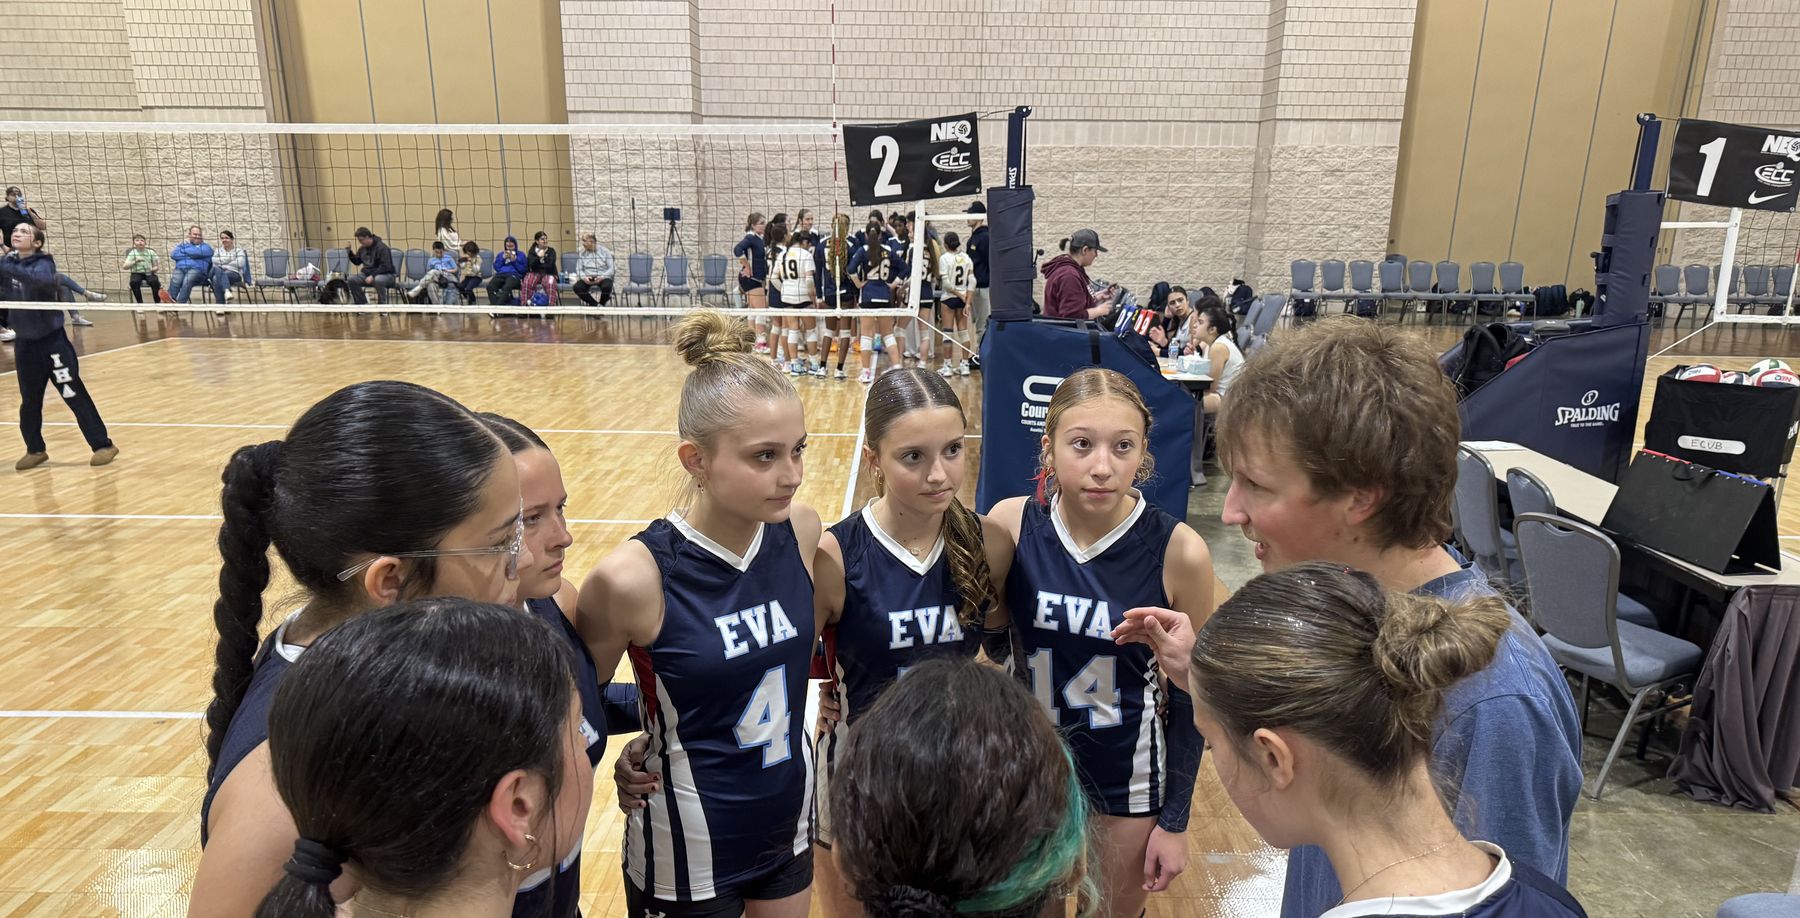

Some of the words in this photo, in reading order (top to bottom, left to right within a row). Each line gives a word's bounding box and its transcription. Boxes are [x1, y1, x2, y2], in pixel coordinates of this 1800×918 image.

[931, 120, 972, 144] NEQ
[940, 152, 971, 166] ECC
[1760, 134, 1800, 162] NEQ
[870, 135, 902, 197] 2
[1696, 137, 1727, 197] 1
[1761, 167, 1795, 181] ECC
[782, 259, 798, 280] 19
[867, 259, 890, 280] 26
[955, 266, 964, 286] 2
[1021, 402, 1048, 418] Cour
[1555, 402, 1621, 426] SPALDING
[888, 605, 965, 650] EVA
[1033, 590, 1114, 641] EVA
[714, 600, 799, 660] EVA
[1027, 647, 1122, 730] 14
[732, 663, 792, 769] 4
